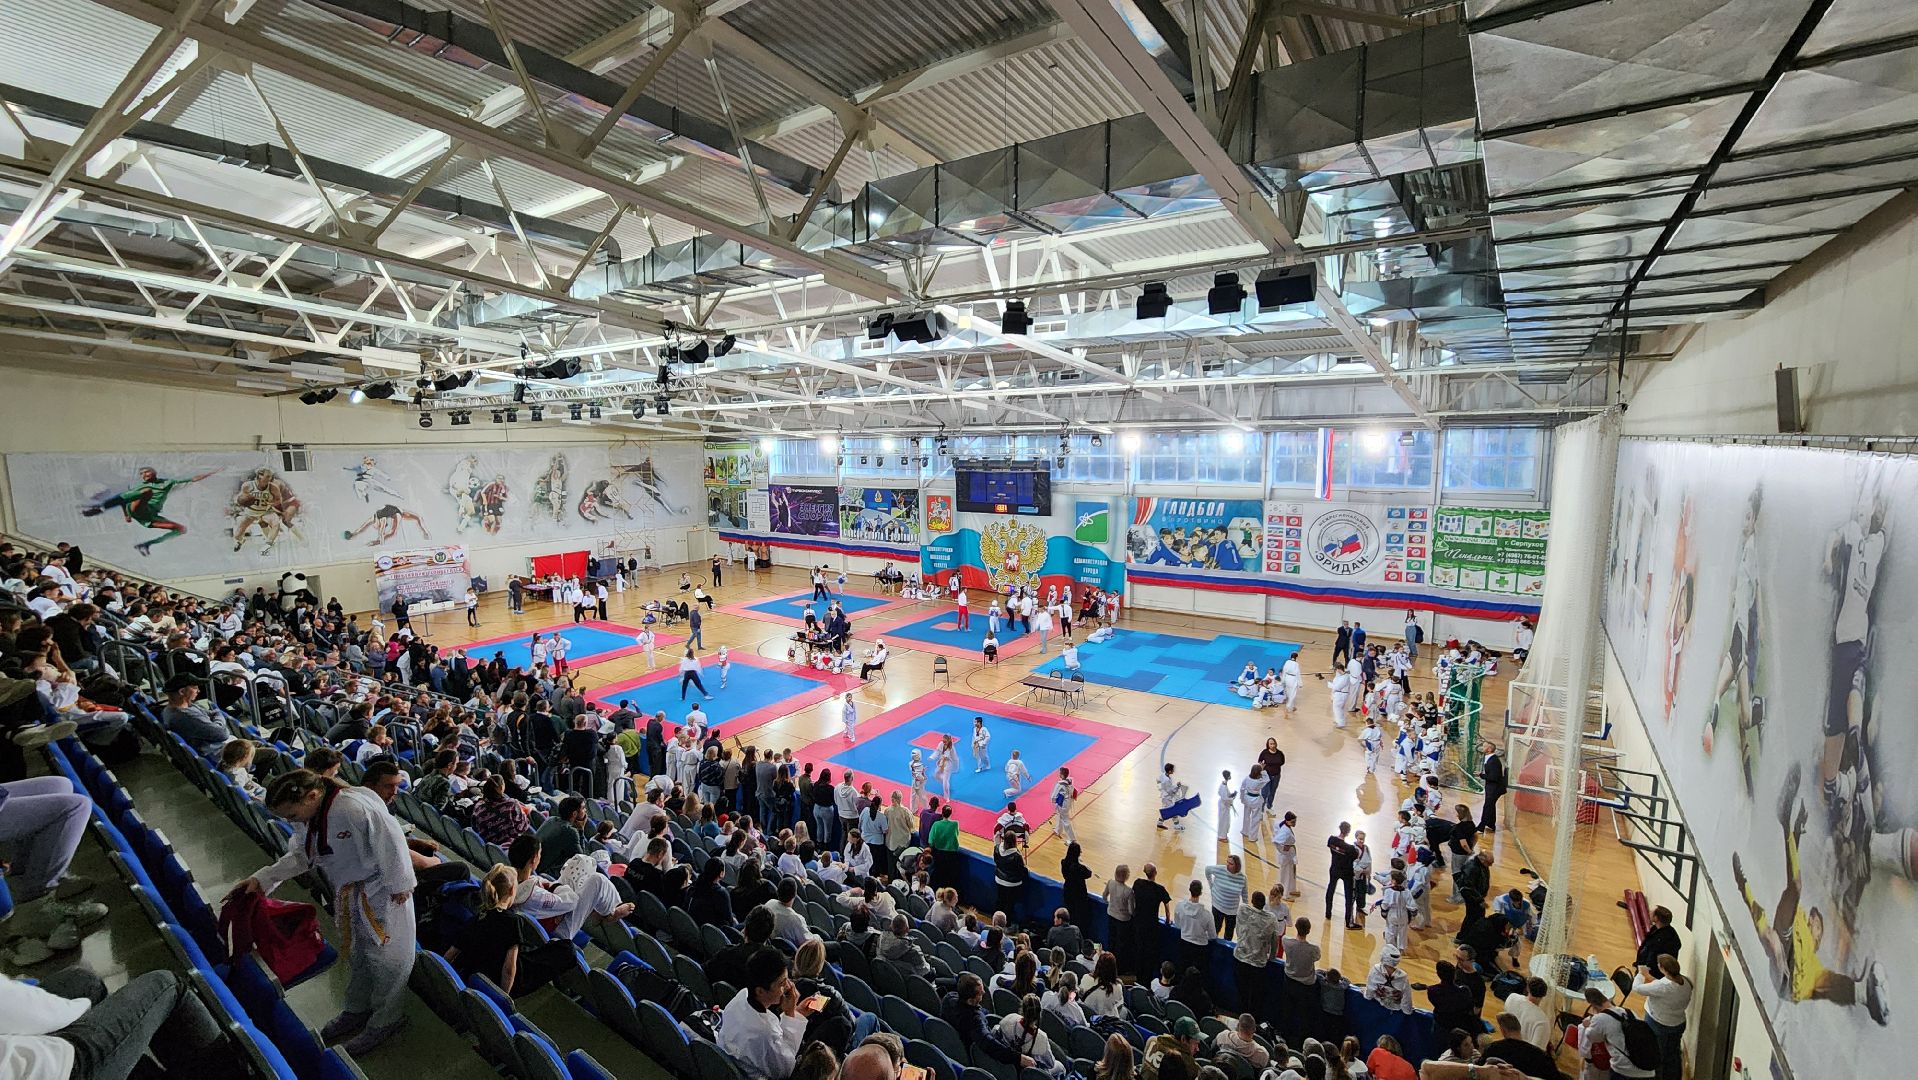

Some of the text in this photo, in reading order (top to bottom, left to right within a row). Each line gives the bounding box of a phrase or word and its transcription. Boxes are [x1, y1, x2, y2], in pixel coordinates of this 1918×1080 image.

[799, 503, 834, 513] ЭНЕРГИЯ
[1162, 501, 1225, 517] ГАНДБОЛ
[798, 511, 834, 522] СПОРТА
[1169, 517, 1223, 525] ПРОТВИНО
[1510, 540, 1544, 549] Серпухов
[1315, 552, 1369, 575] ЭРИДАН
